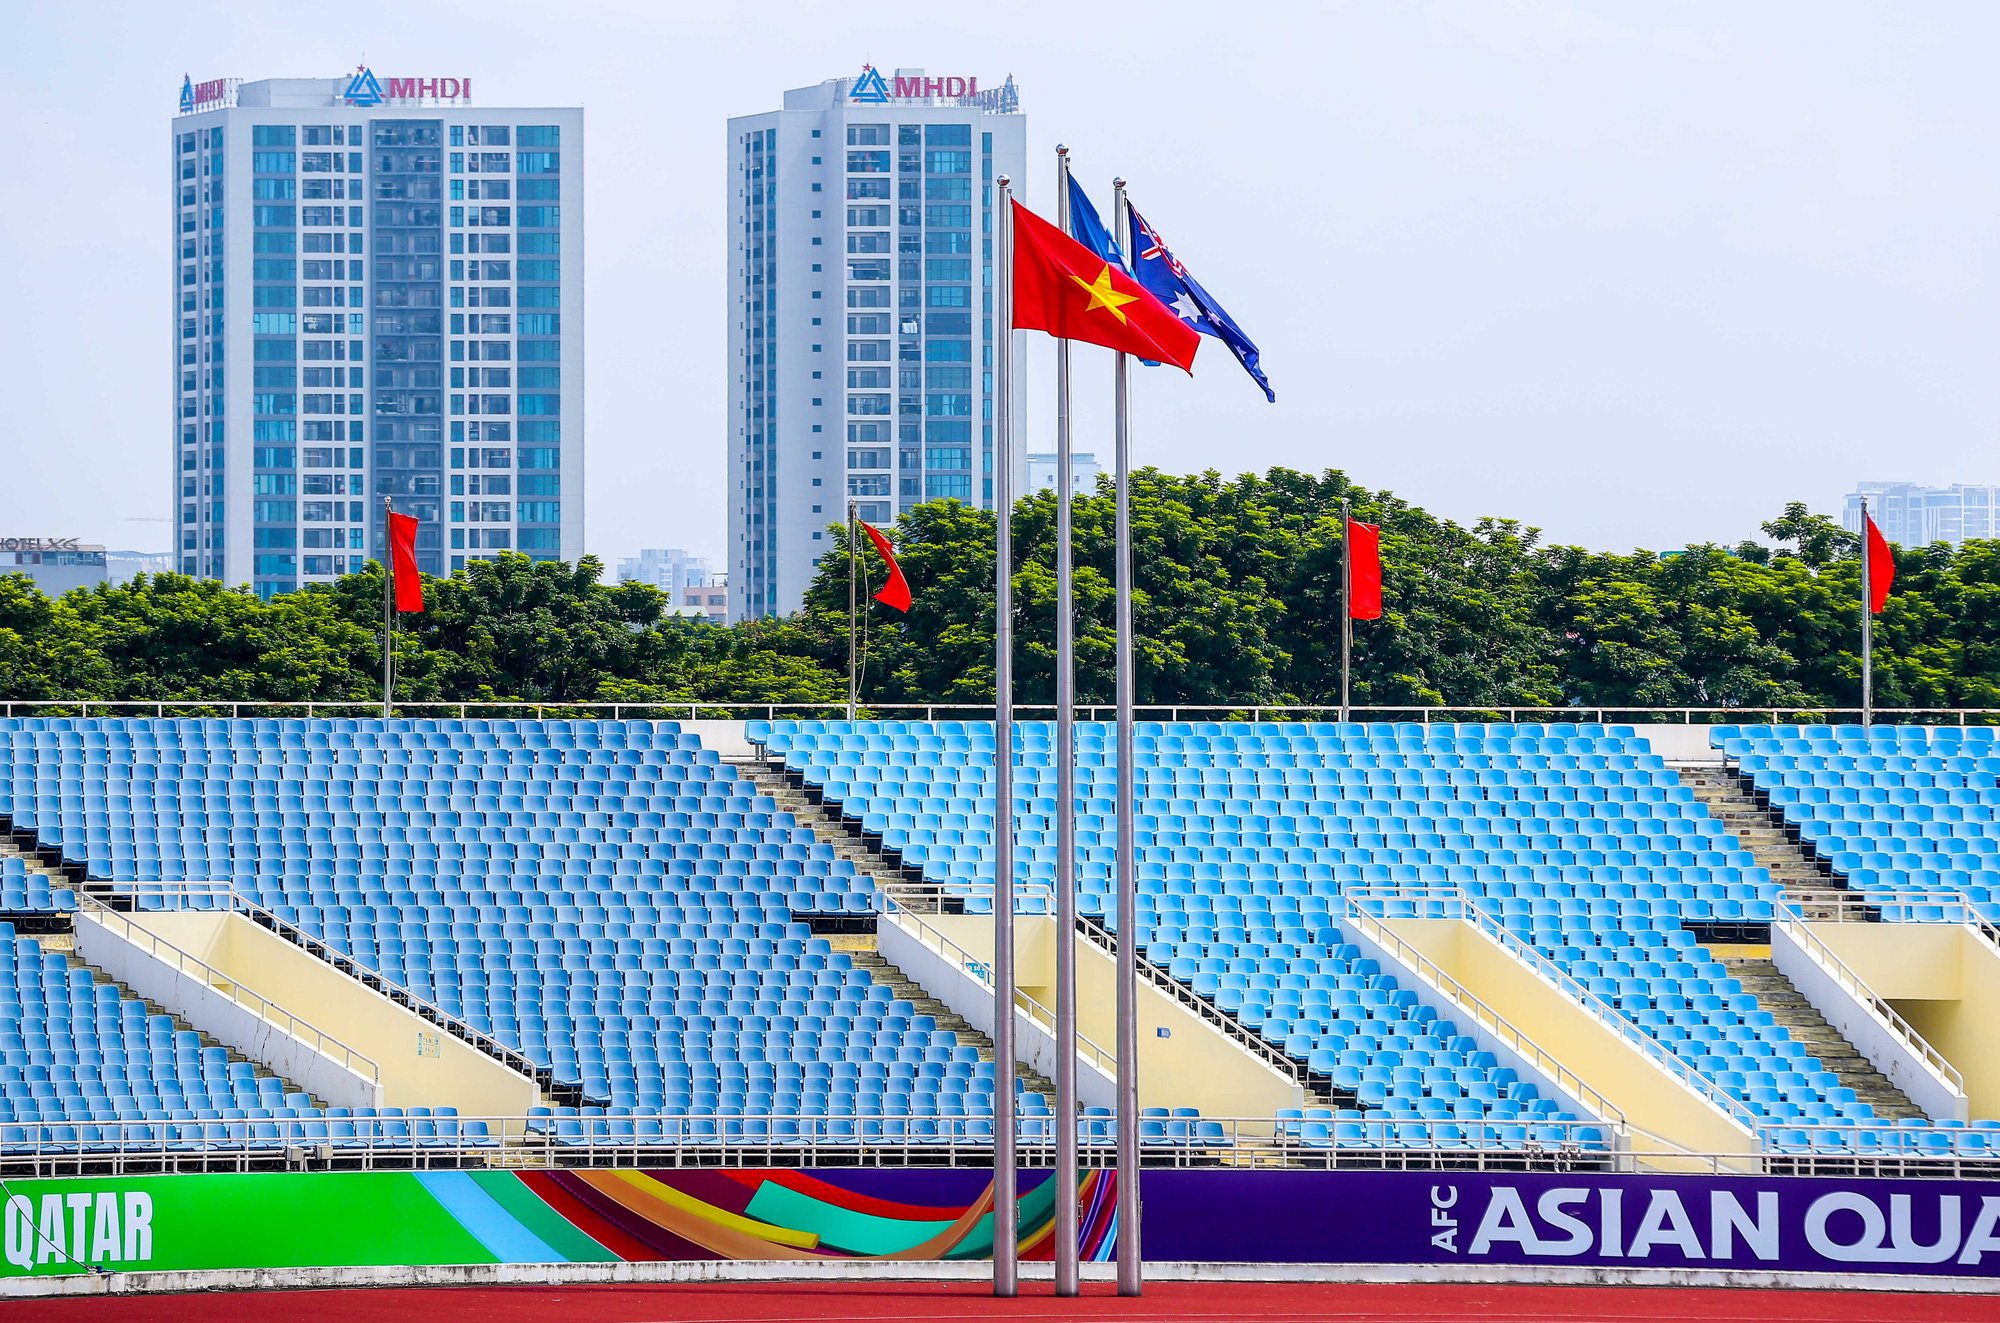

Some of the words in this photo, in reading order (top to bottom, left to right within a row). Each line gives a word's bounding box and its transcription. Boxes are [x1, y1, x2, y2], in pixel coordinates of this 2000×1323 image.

[195, 79, 223, 104] MHDI
[390, 78, 470, 98] MHDI
[895, 77, 977, 97] MHDI
[5, 1192, 153, 1271] QATAR
[1431, 1185, 1458, 1254] AFC
[1468, 1187, 1779, 1260] ASIAN
